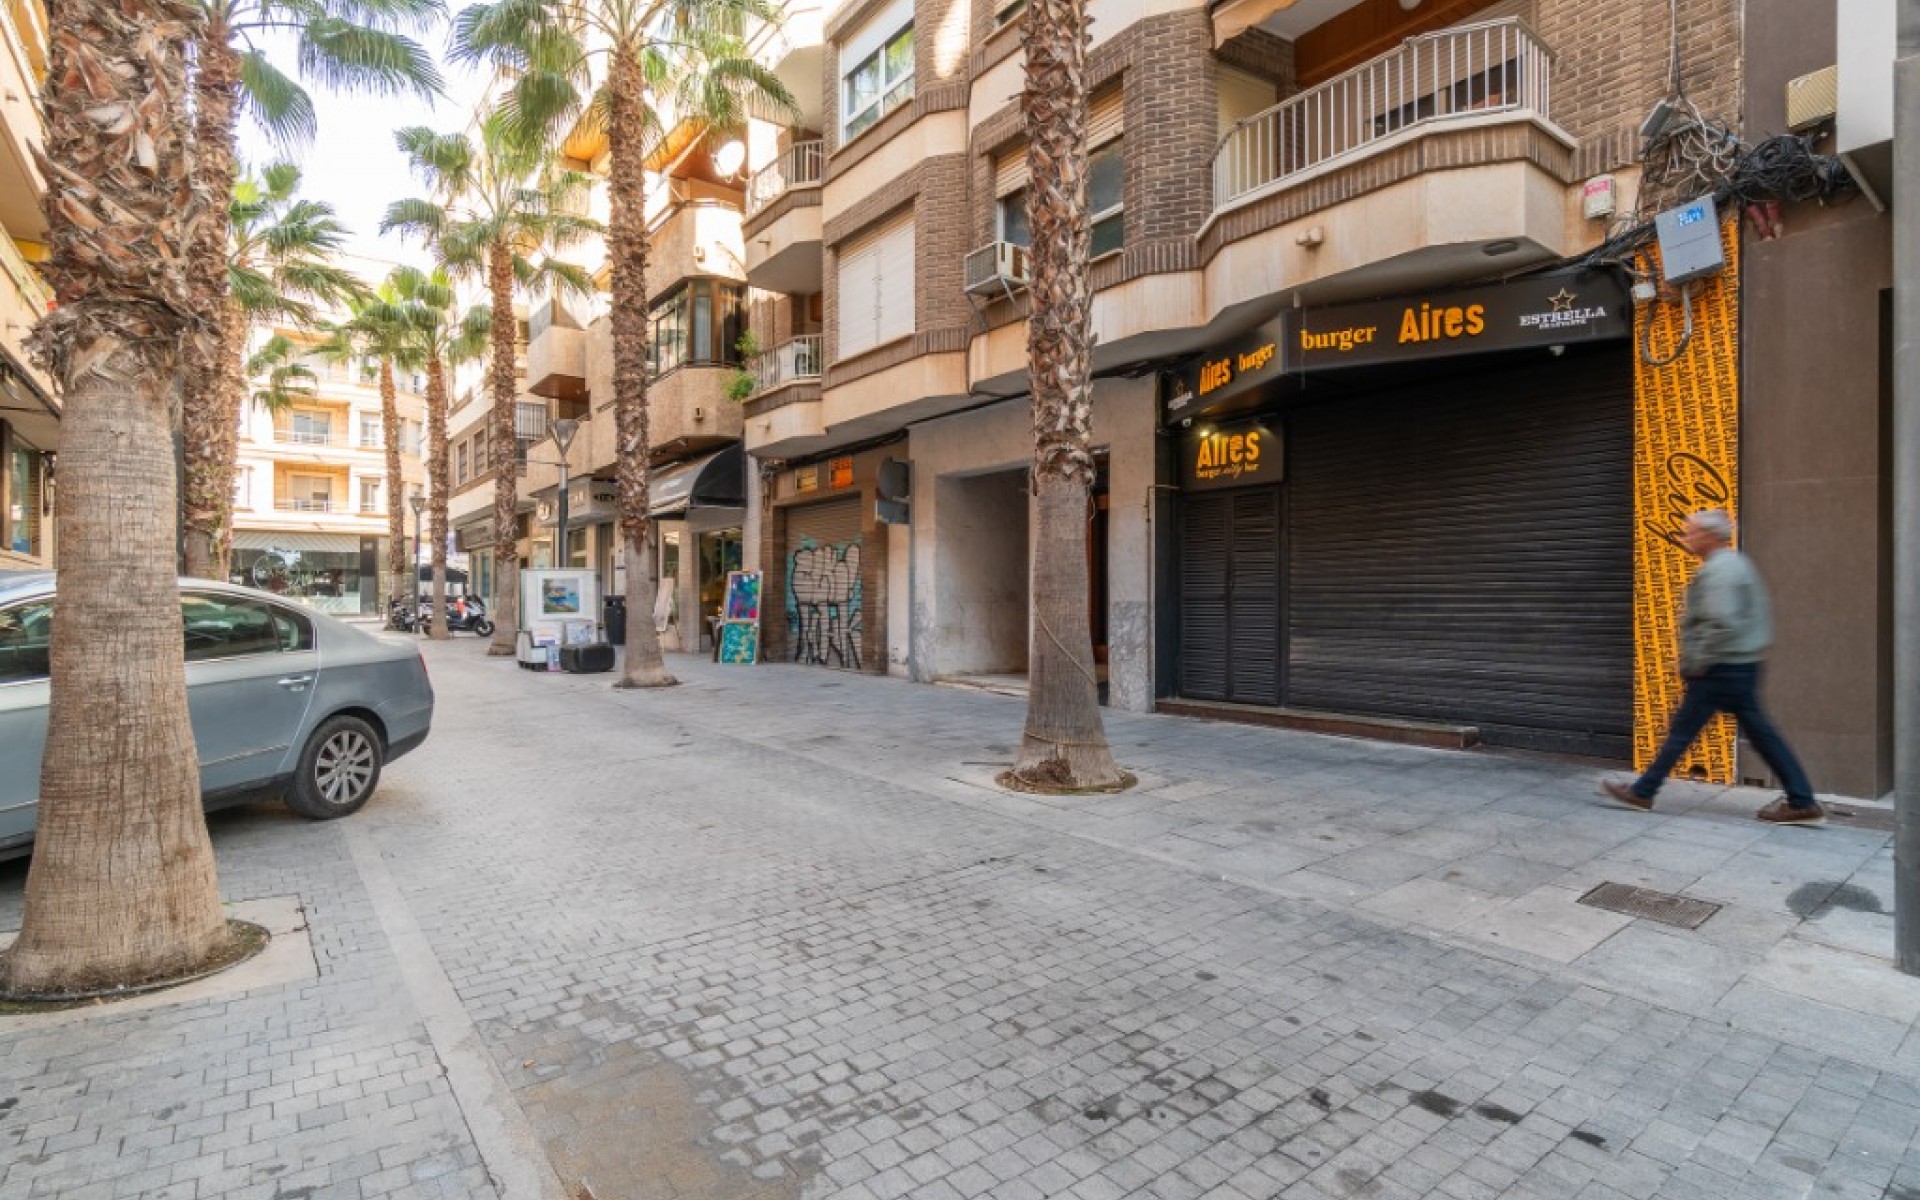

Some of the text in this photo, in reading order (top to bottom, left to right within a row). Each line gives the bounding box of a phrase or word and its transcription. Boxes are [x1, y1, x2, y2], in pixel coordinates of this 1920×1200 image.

[1301, 303, 1485, 351] burger Aires
[1519, 306, 1607, 326] ESTRELLA
[1199, 343, 1276, 396] Aires burger
[1197, 431, 1260, 468] Aires
